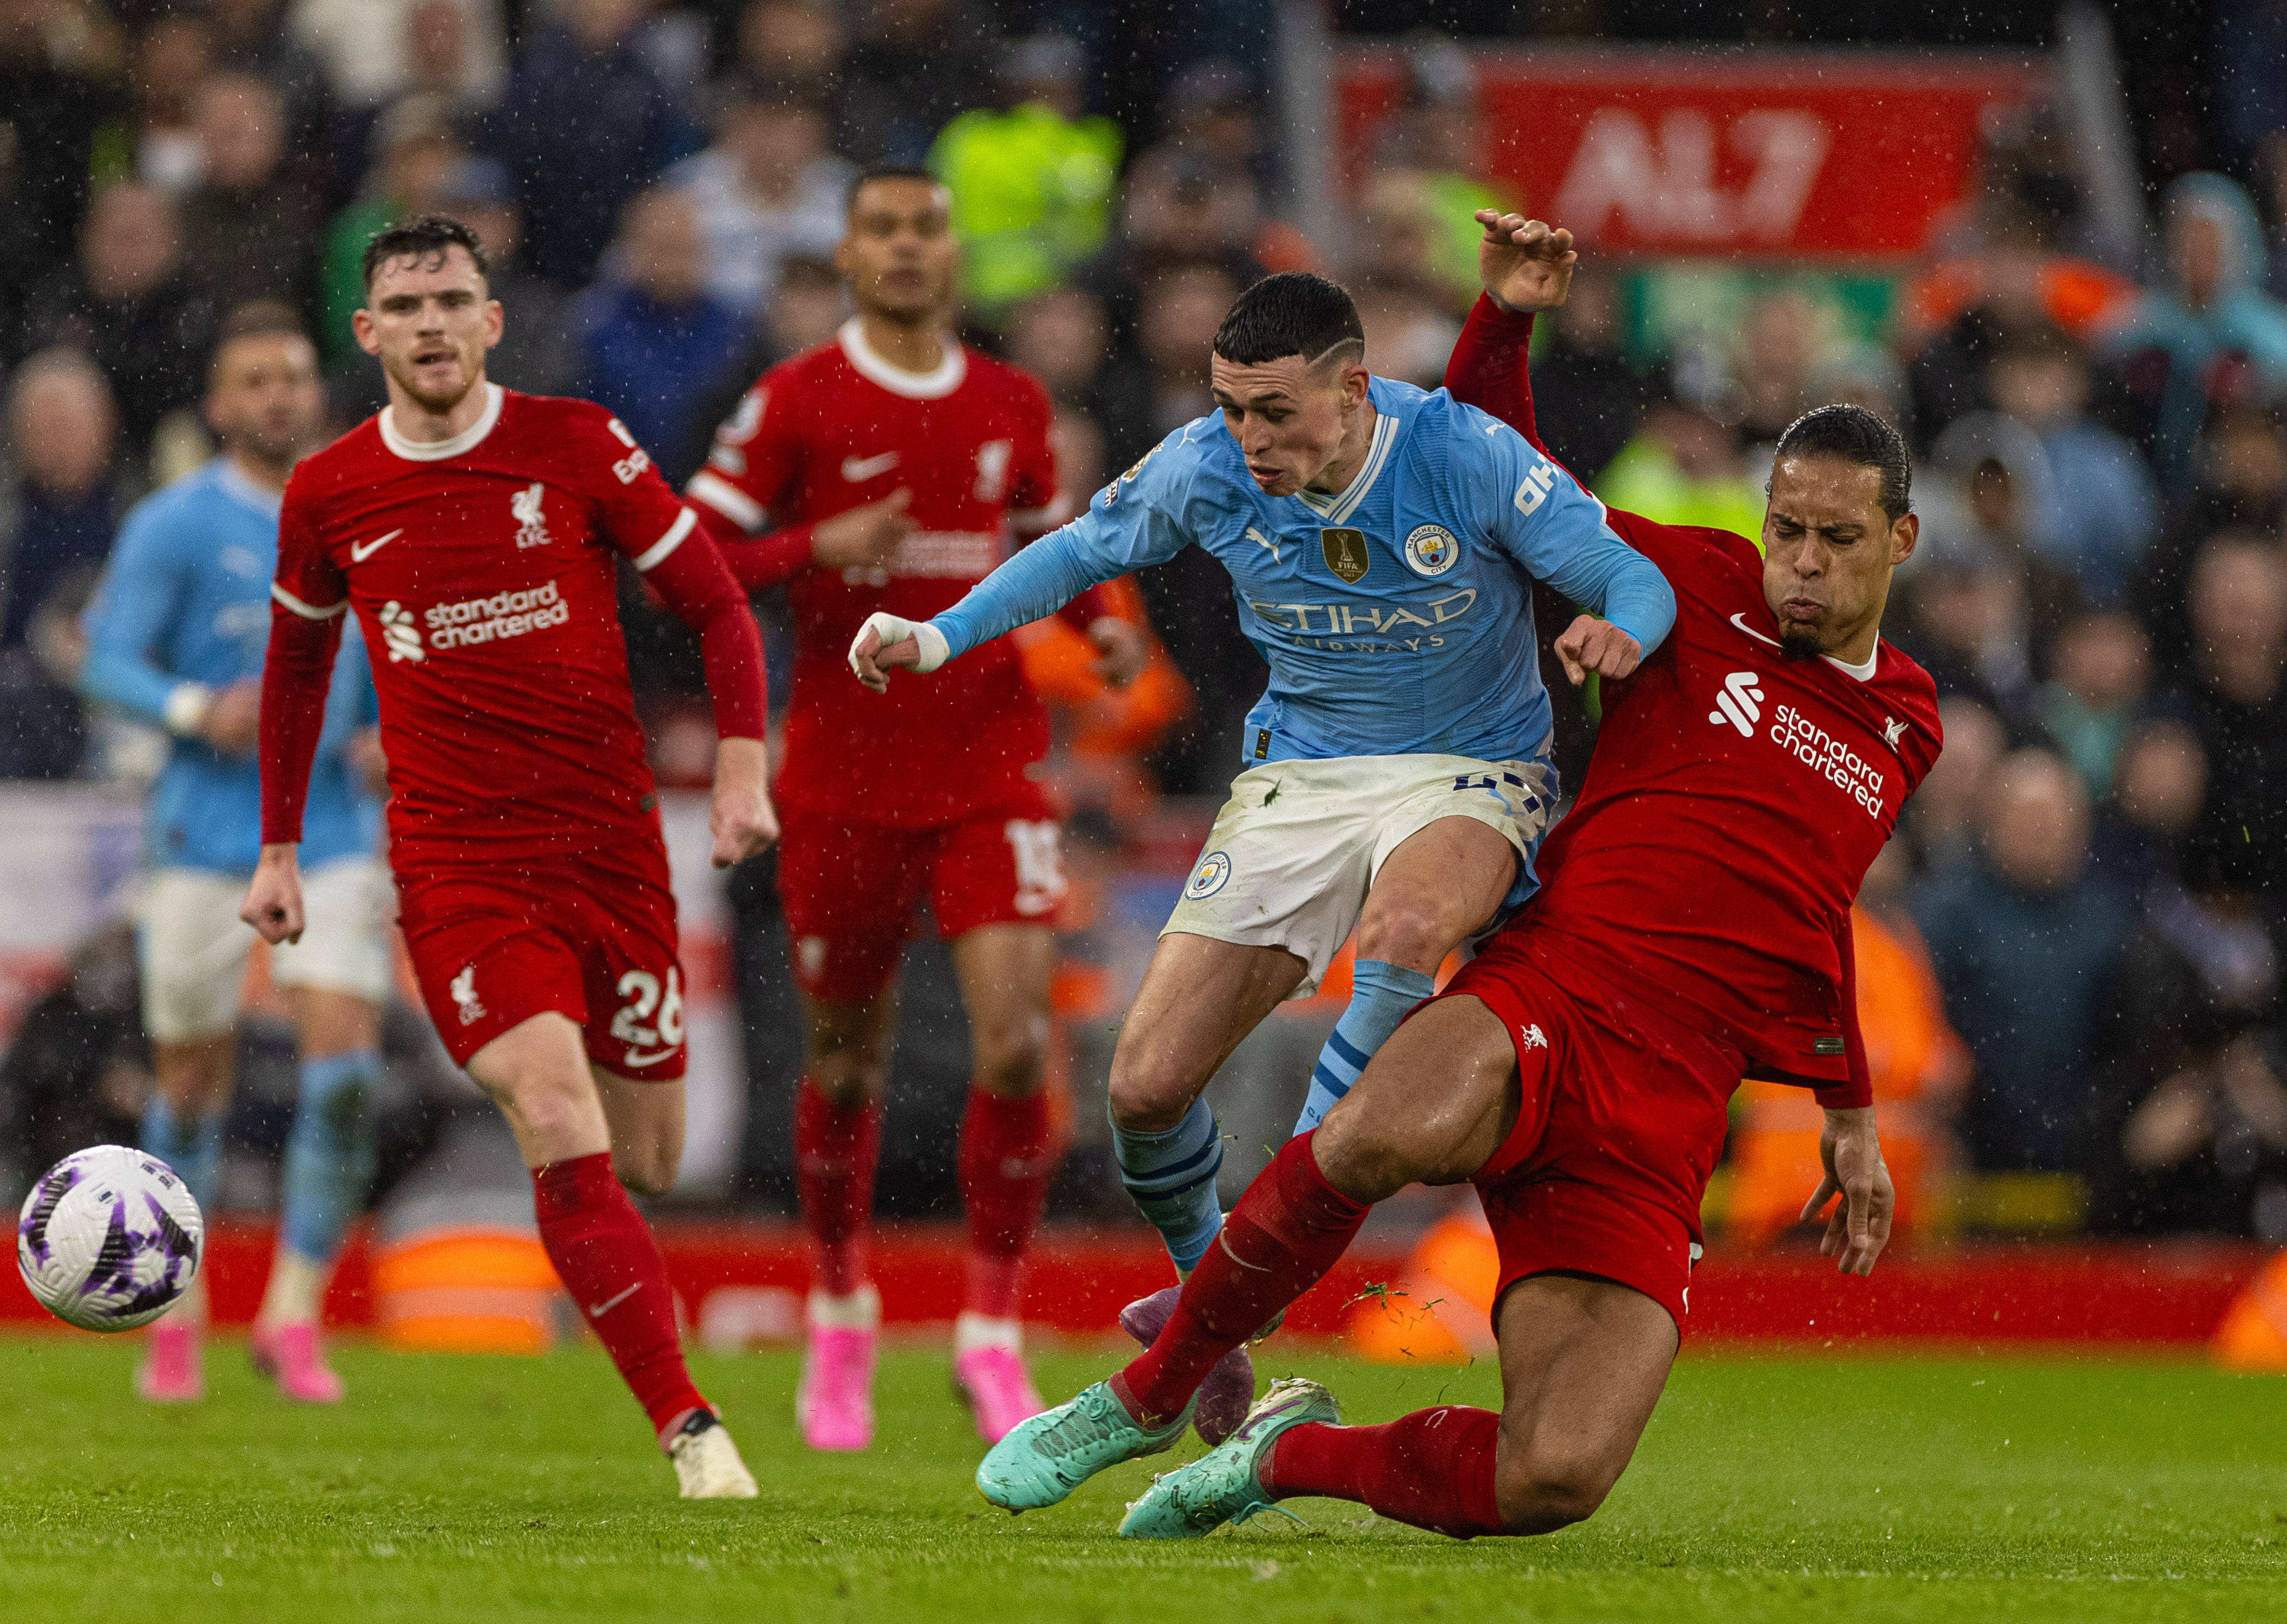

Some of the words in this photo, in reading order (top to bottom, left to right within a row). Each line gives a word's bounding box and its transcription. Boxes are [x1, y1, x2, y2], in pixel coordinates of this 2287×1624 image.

[1408, 526, 1450, 549] MANCHESTER
[1338, 562, 1358, 570] FIFA
[1431, 564, 1447, 574] CITY
[424, 579, 559, 629] standard
[429, 598, 569, 649] chartered
[1250, 588, 1476, 633] ETIHAD
[1770, 725, 1884, 819] chartered
[1775, 705, 1884, 794] standard
[610, 966, 683, 1046] 26
